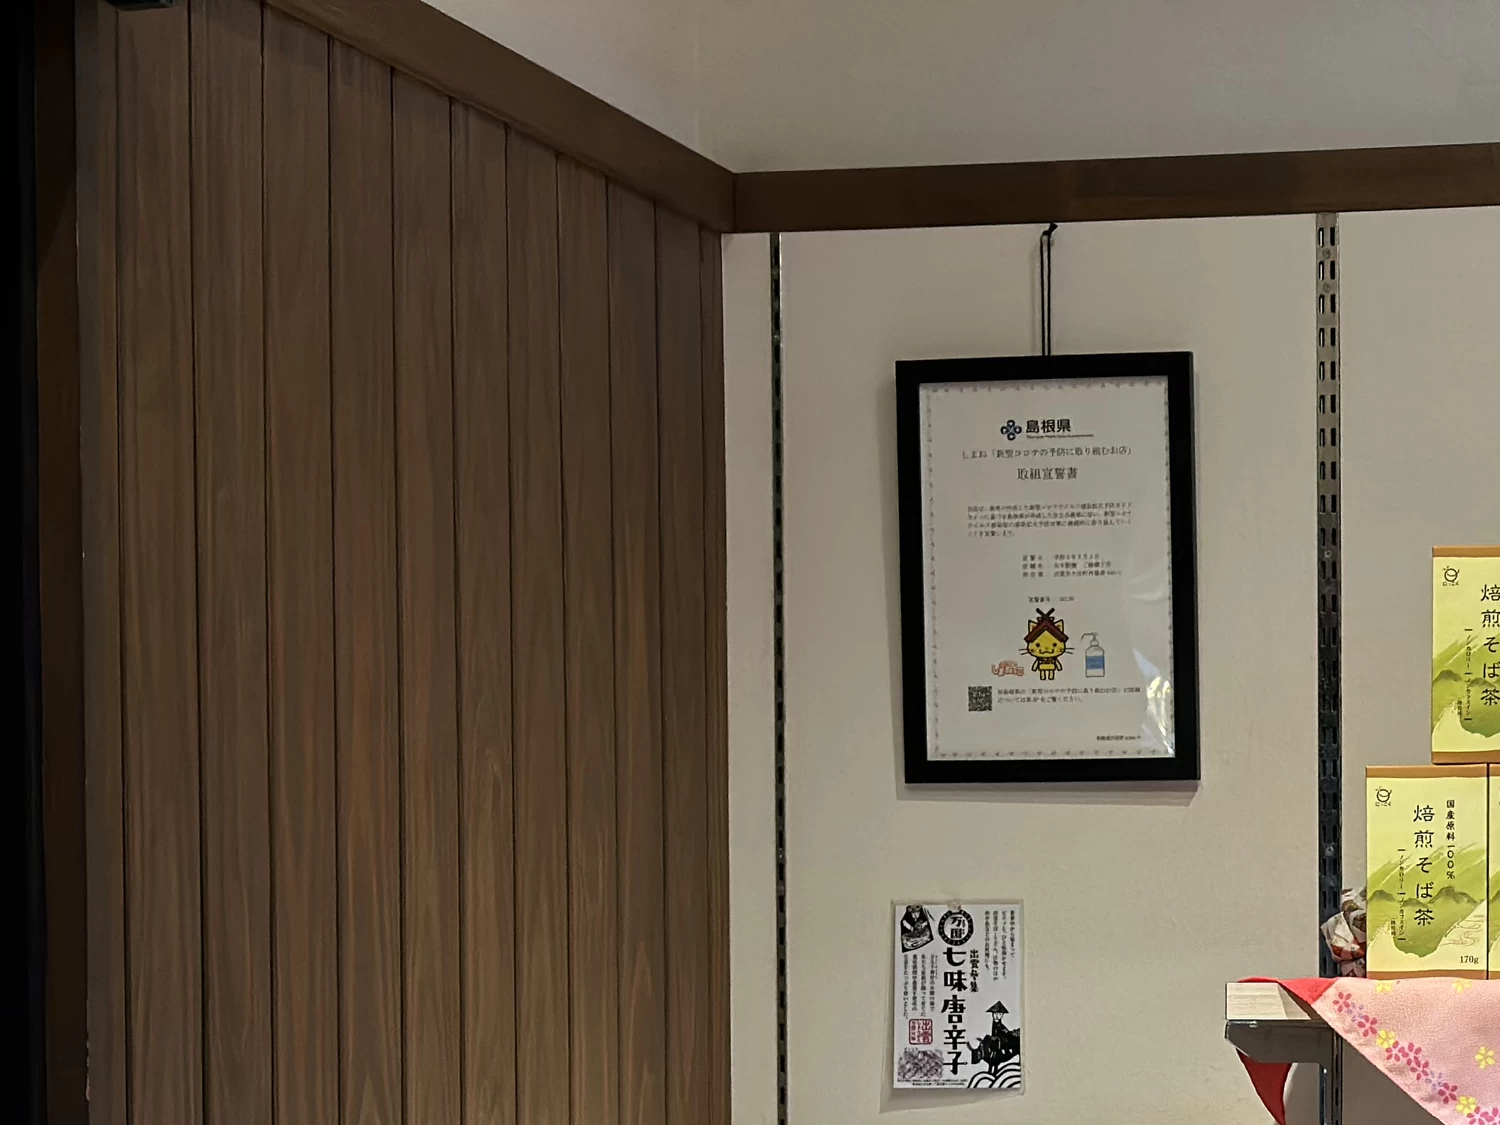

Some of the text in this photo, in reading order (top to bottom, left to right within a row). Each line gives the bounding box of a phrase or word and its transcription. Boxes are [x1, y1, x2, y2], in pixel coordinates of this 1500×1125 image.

[1026, 418, 1072, 434] 島根県
[1017, 466, 1078, 481] 取組宣誓書
[1413, 804, 1435, 927] 焙煎そば茶
[1460, 955, 1479, 965] 170g
[941, 947, 968, 1076] 七味唐辛子
